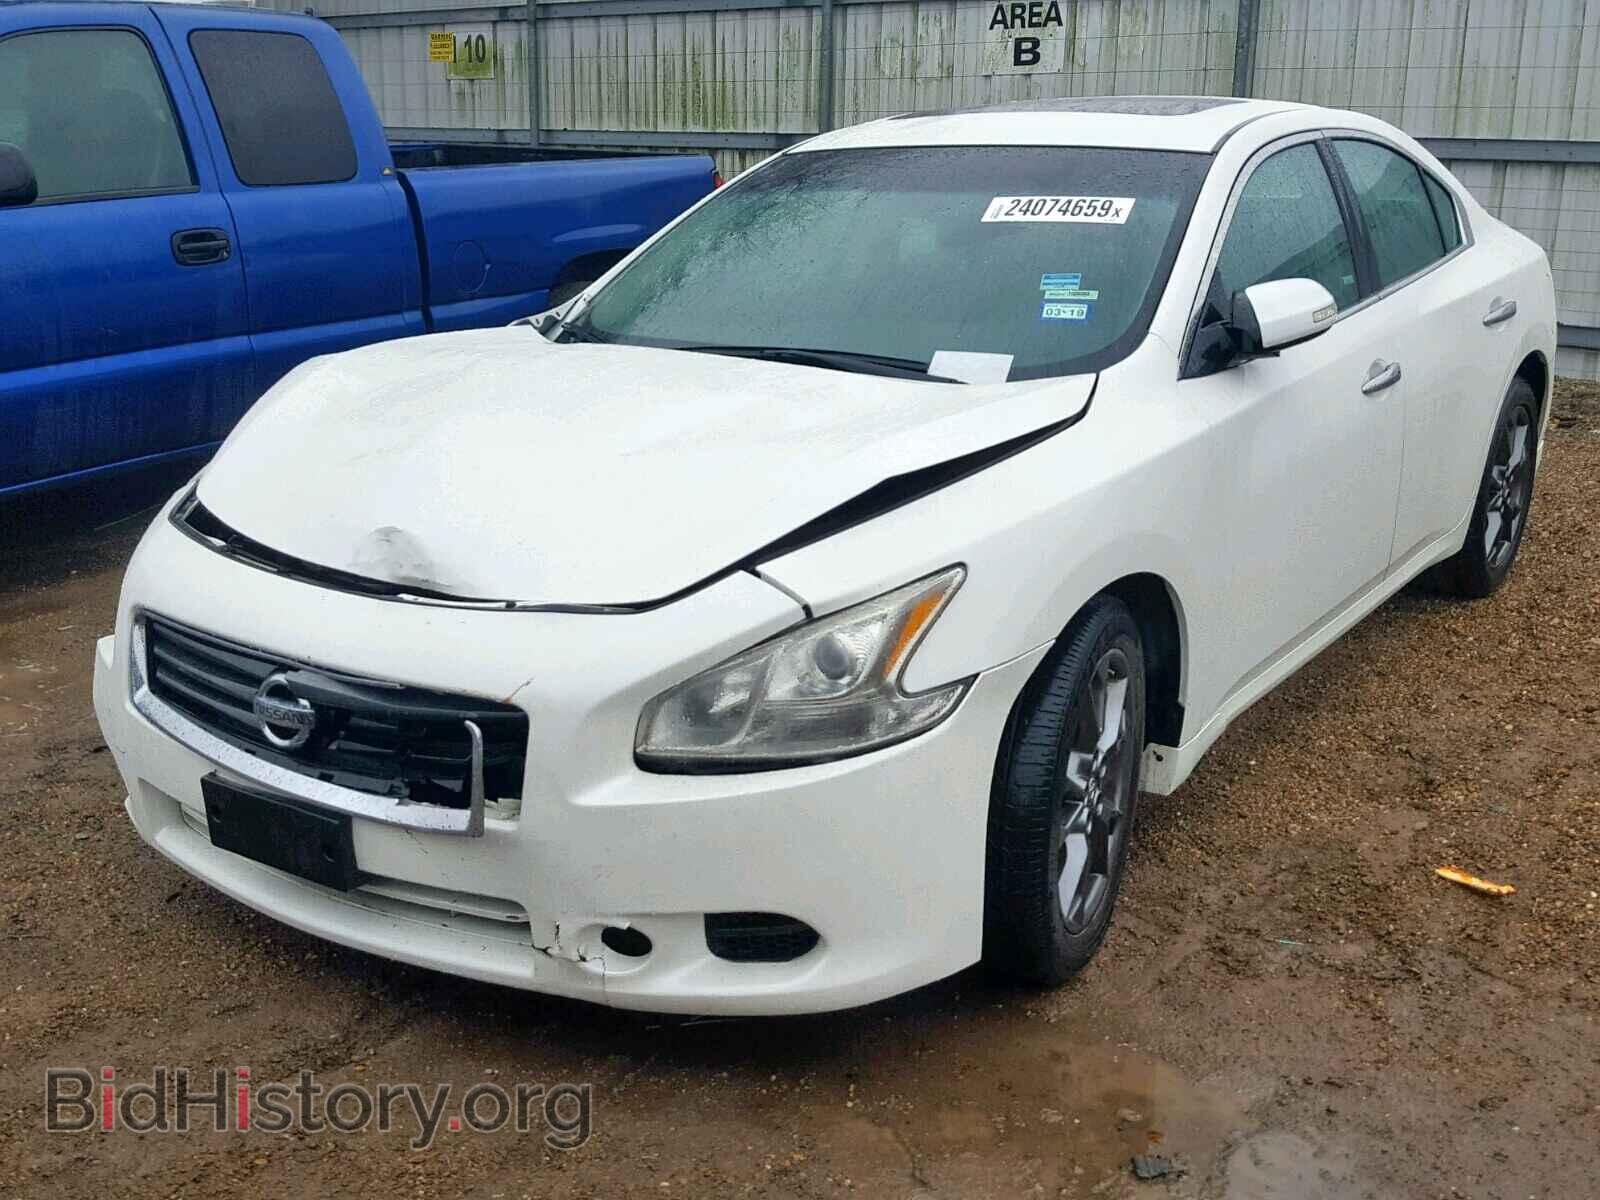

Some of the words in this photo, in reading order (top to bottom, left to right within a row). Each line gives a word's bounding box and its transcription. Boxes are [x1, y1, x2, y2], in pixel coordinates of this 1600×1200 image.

[988, 0, 1064, 30] AREA
[464, 34, 486, 63] 10
[1013, 36, 1041, 67] B
